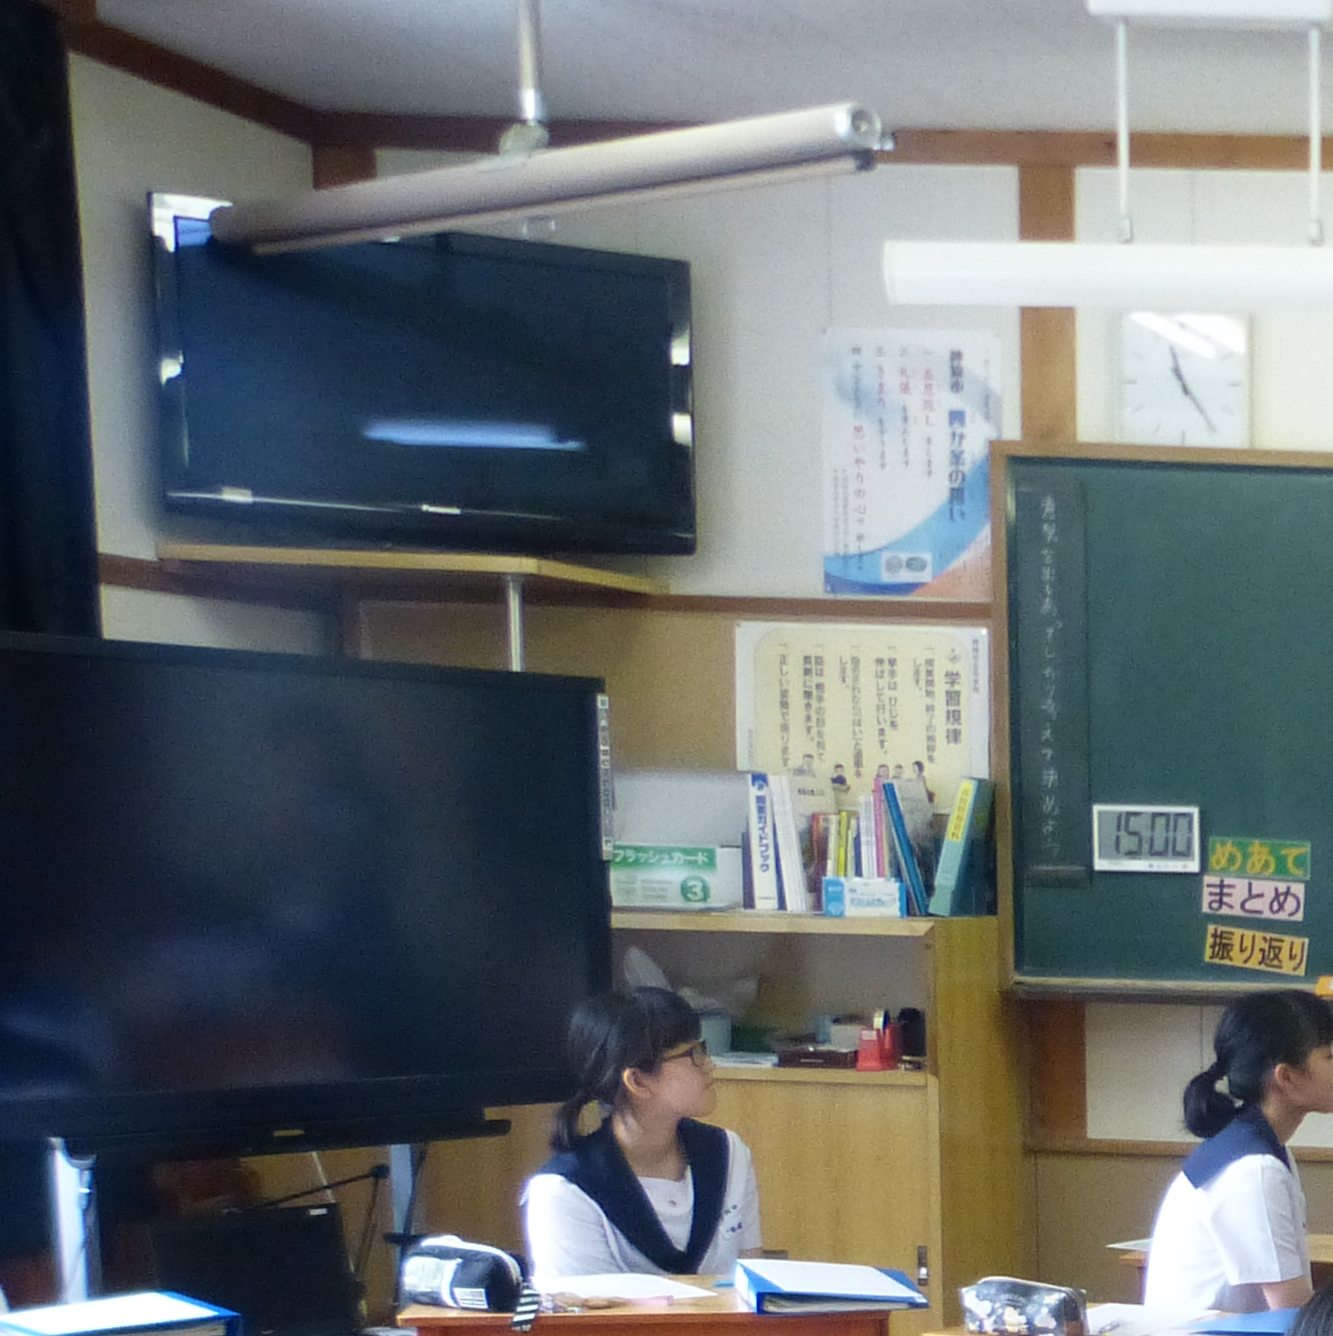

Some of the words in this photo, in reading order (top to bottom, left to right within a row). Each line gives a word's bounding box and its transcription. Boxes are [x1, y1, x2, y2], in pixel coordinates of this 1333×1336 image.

[1211, 839, 1308, 876] めあて
[686, 880, 704, 902] 3
[1206, 879, 1302, 917] まとめ
[1208, 927, 1307, 972] 振り返り
